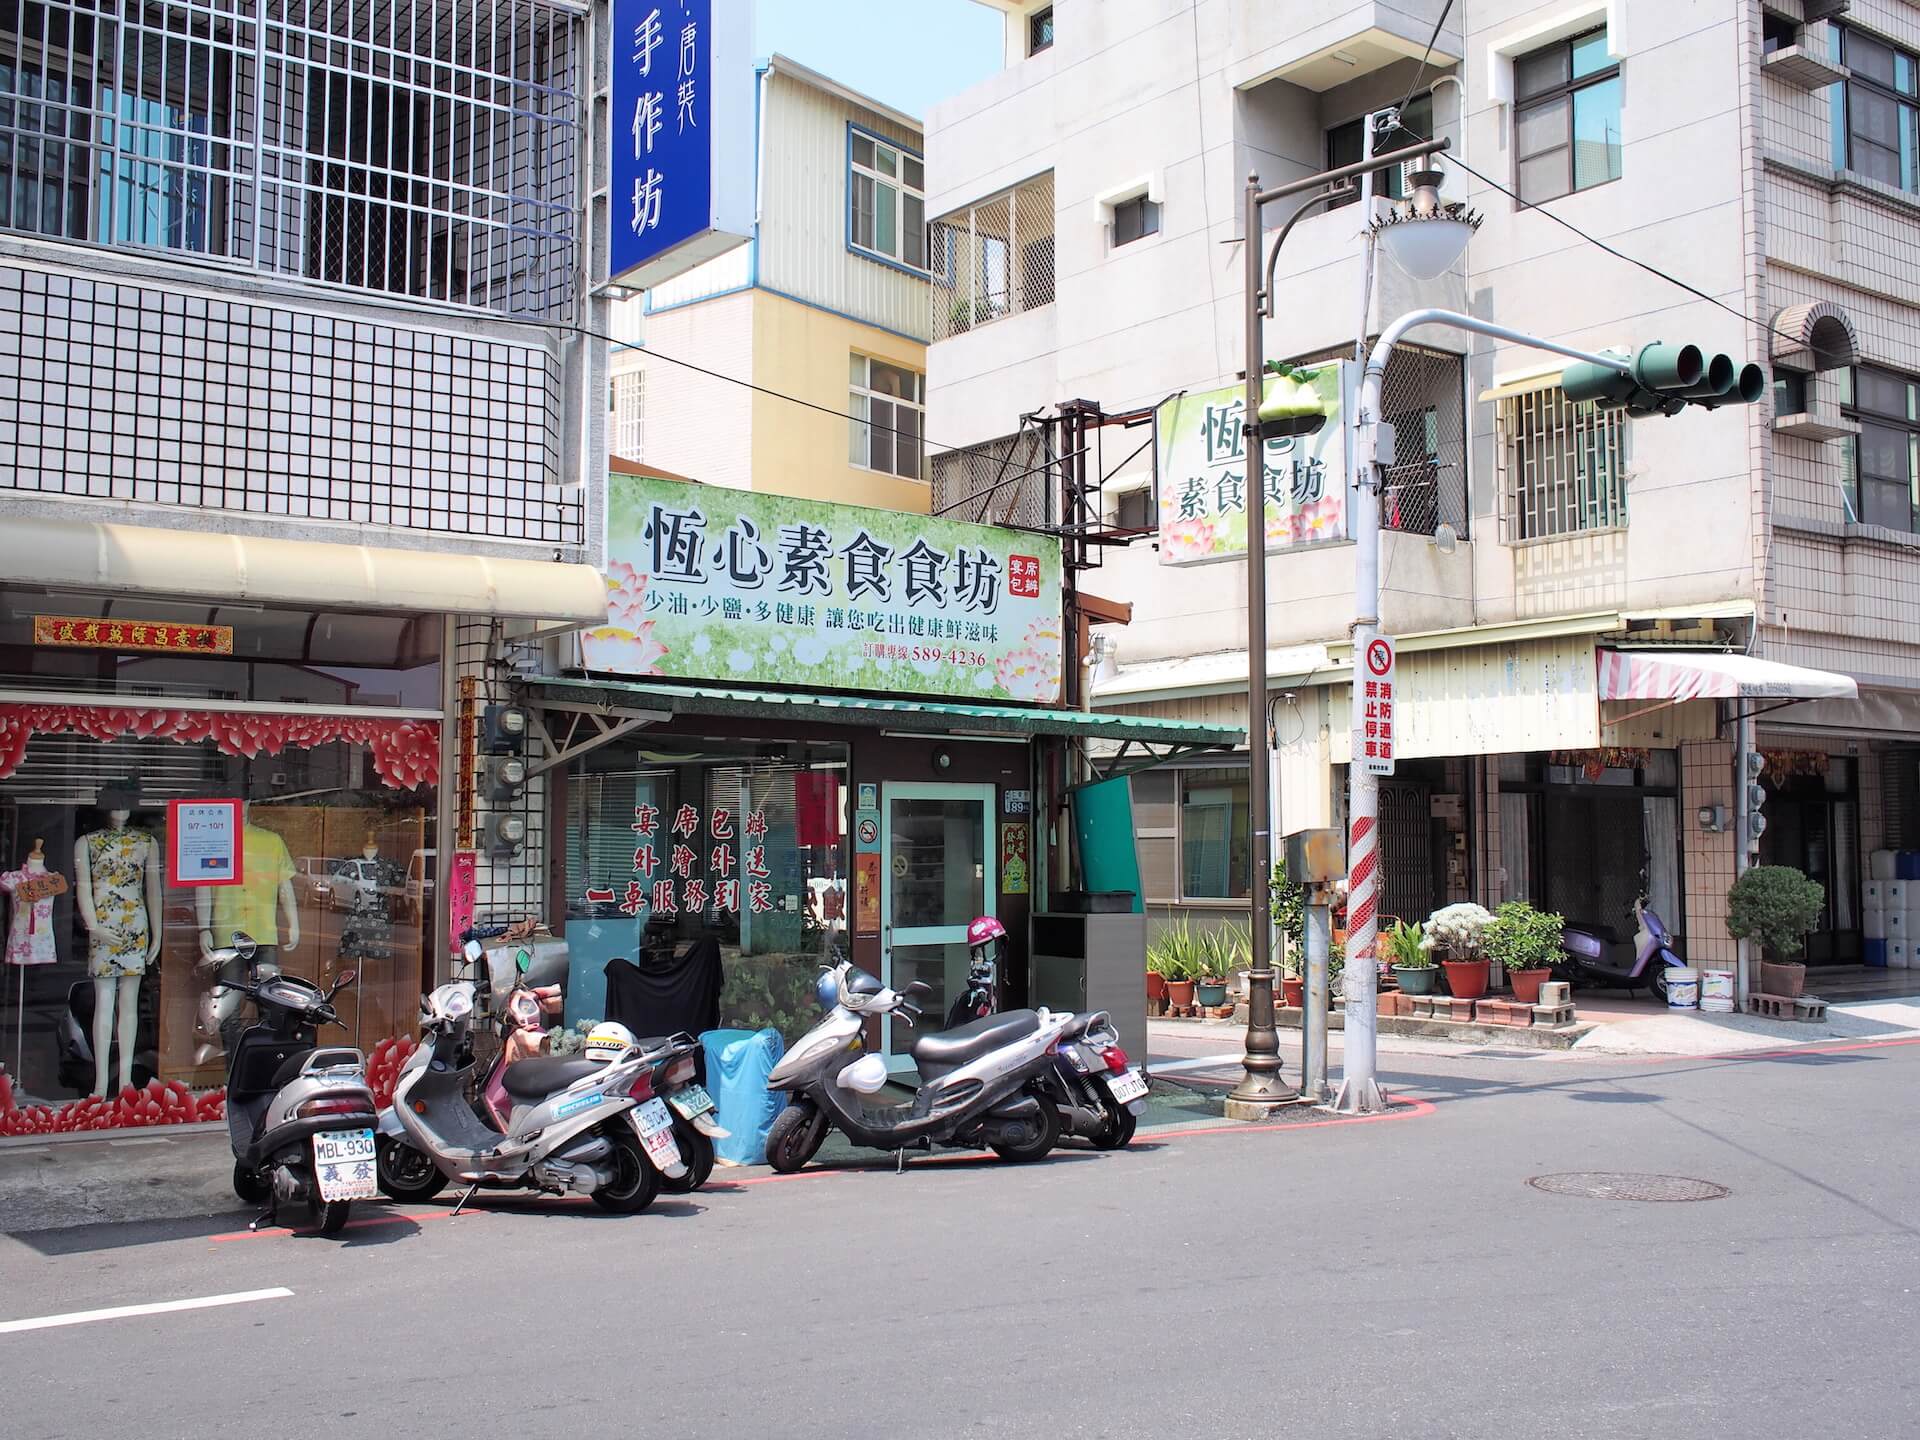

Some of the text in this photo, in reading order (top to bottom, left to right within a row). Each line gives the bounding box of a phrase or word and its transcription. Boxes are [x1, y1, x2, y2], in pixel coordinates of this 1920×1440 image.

[677, 0, 697, 136] ·唐裝
[631, 8, 664, 237] 手作坊
[643, 504, 1002, 613] 恆心素食食坊
[825, 606, 1000, 643] 讓您吃出健康鮮滋味
[911, 646, 986, 667] 589-4236
[1365, 681, 1378, 758] 禁止停車
[1379, 683, 1392, 760] 消防通道
[586, 878, 773, 914] 一桌服務到家
[631, 843, 771, 878] 外燴外送
